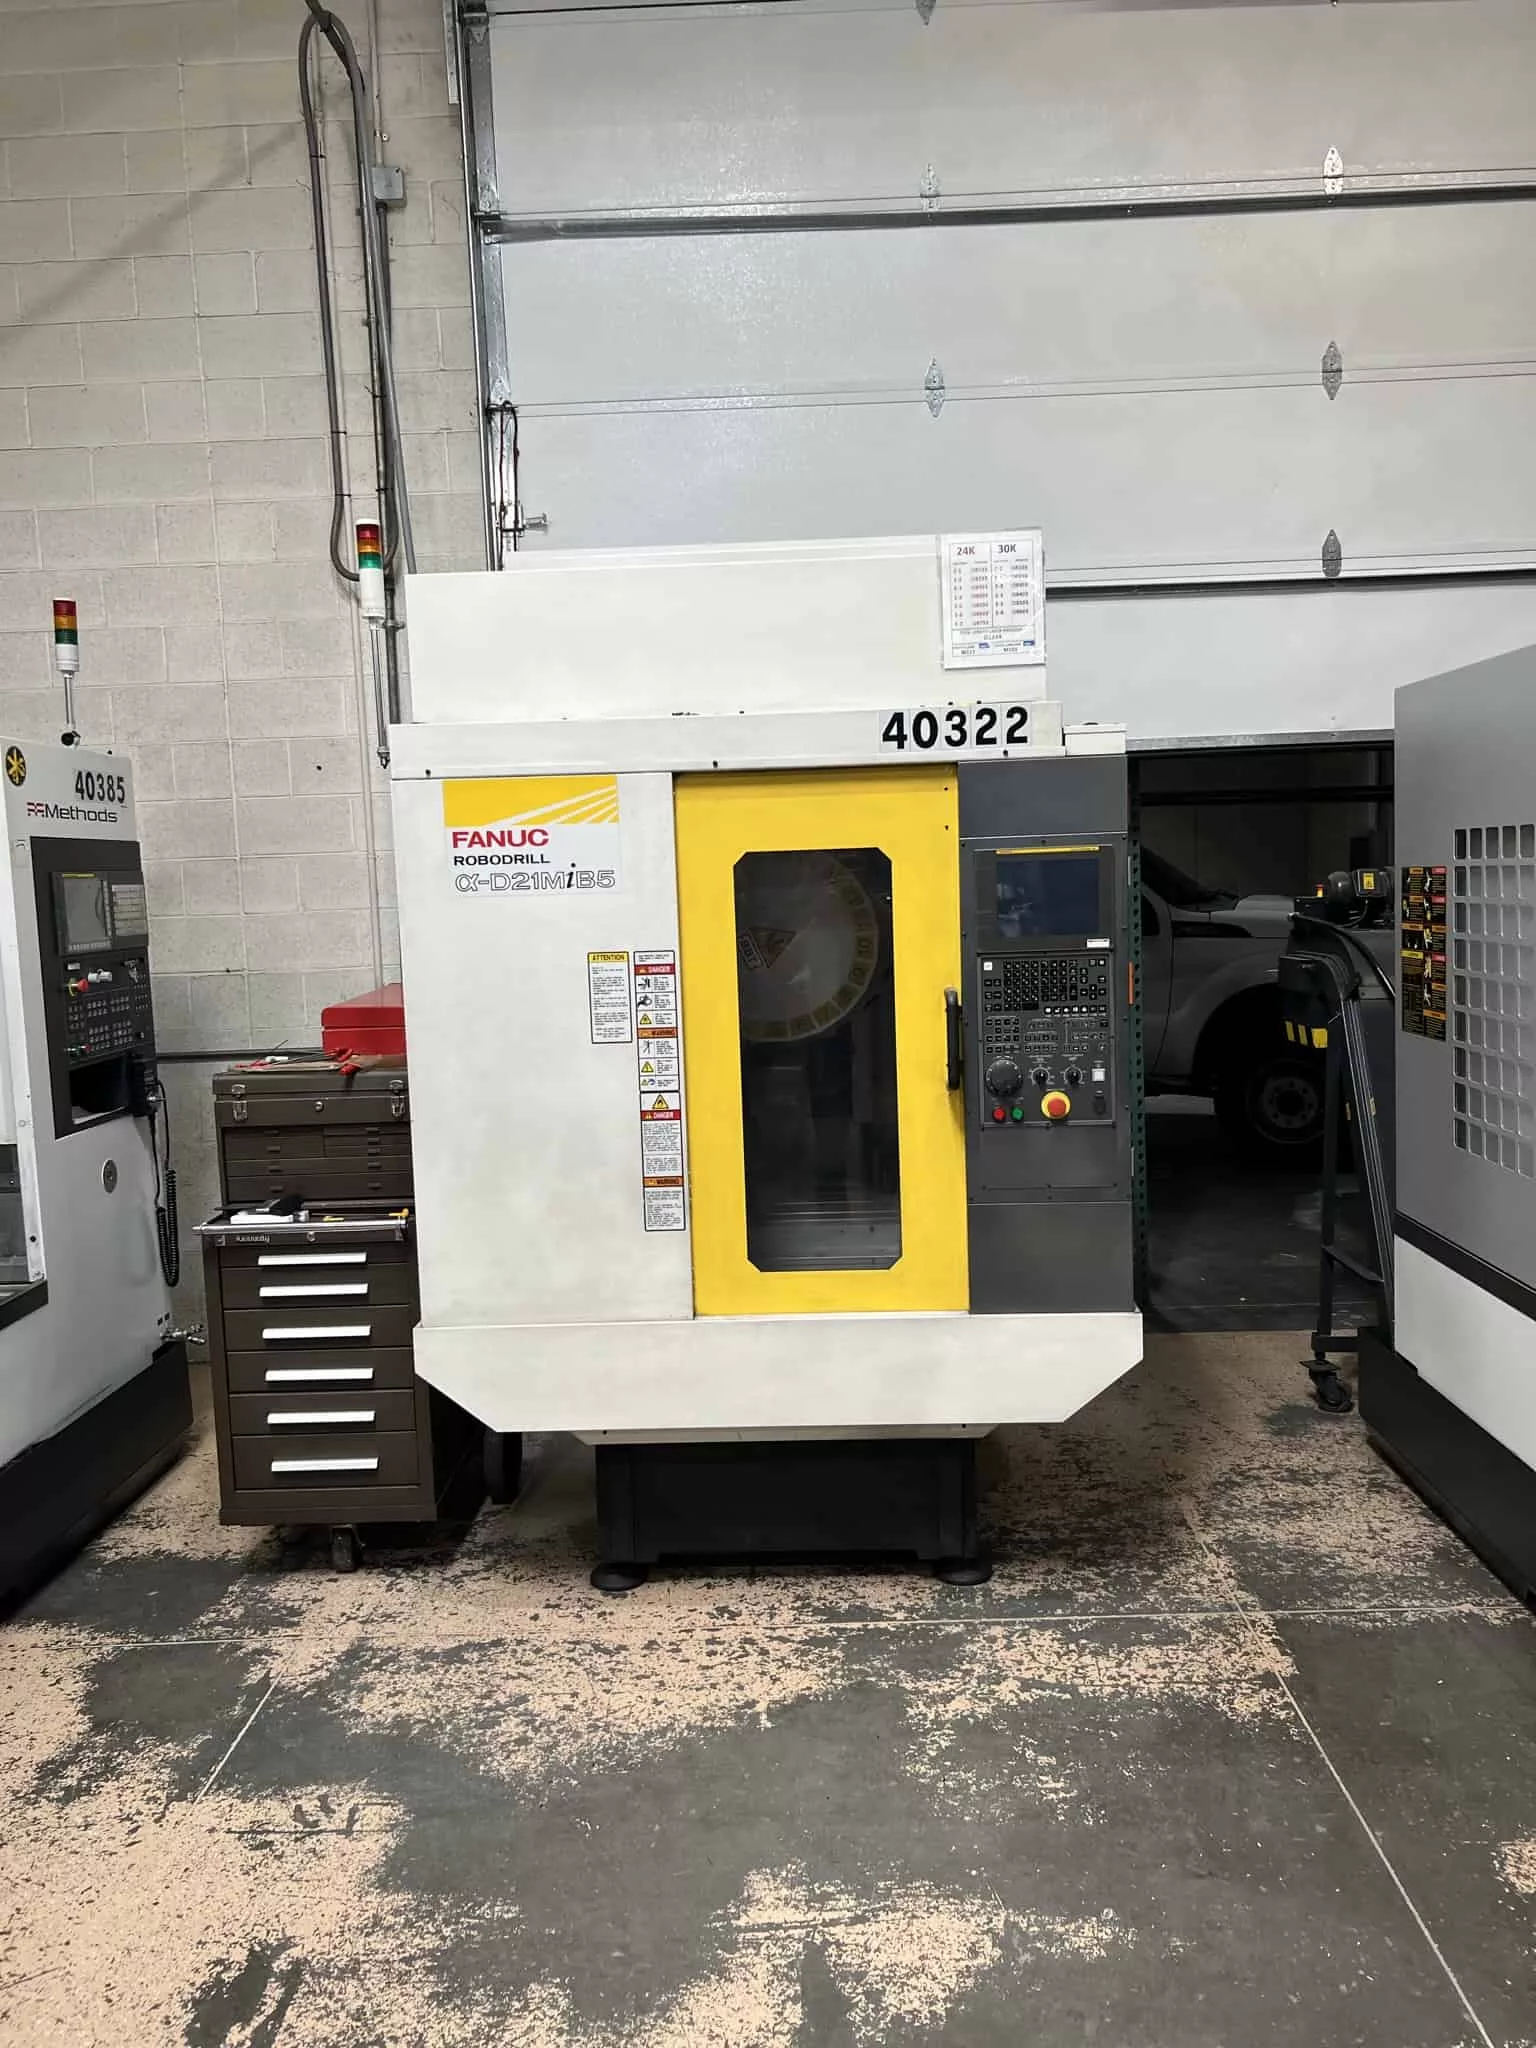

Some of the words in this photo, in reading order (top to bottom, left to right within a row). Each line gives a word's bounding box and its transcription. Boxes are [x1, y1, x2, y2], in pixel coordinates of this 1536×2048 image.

[956, 546, 976, 556] 24K
[997, 543, 1017, 554] 30K
[882, 706, 1028, 750] 40322
[75, 770, 126, 804] 40385
[45, 804, 118, 823] Methods
[452, 828, 549, 848] FANUC
[453, 853, 551, 866] ROBODRILL
